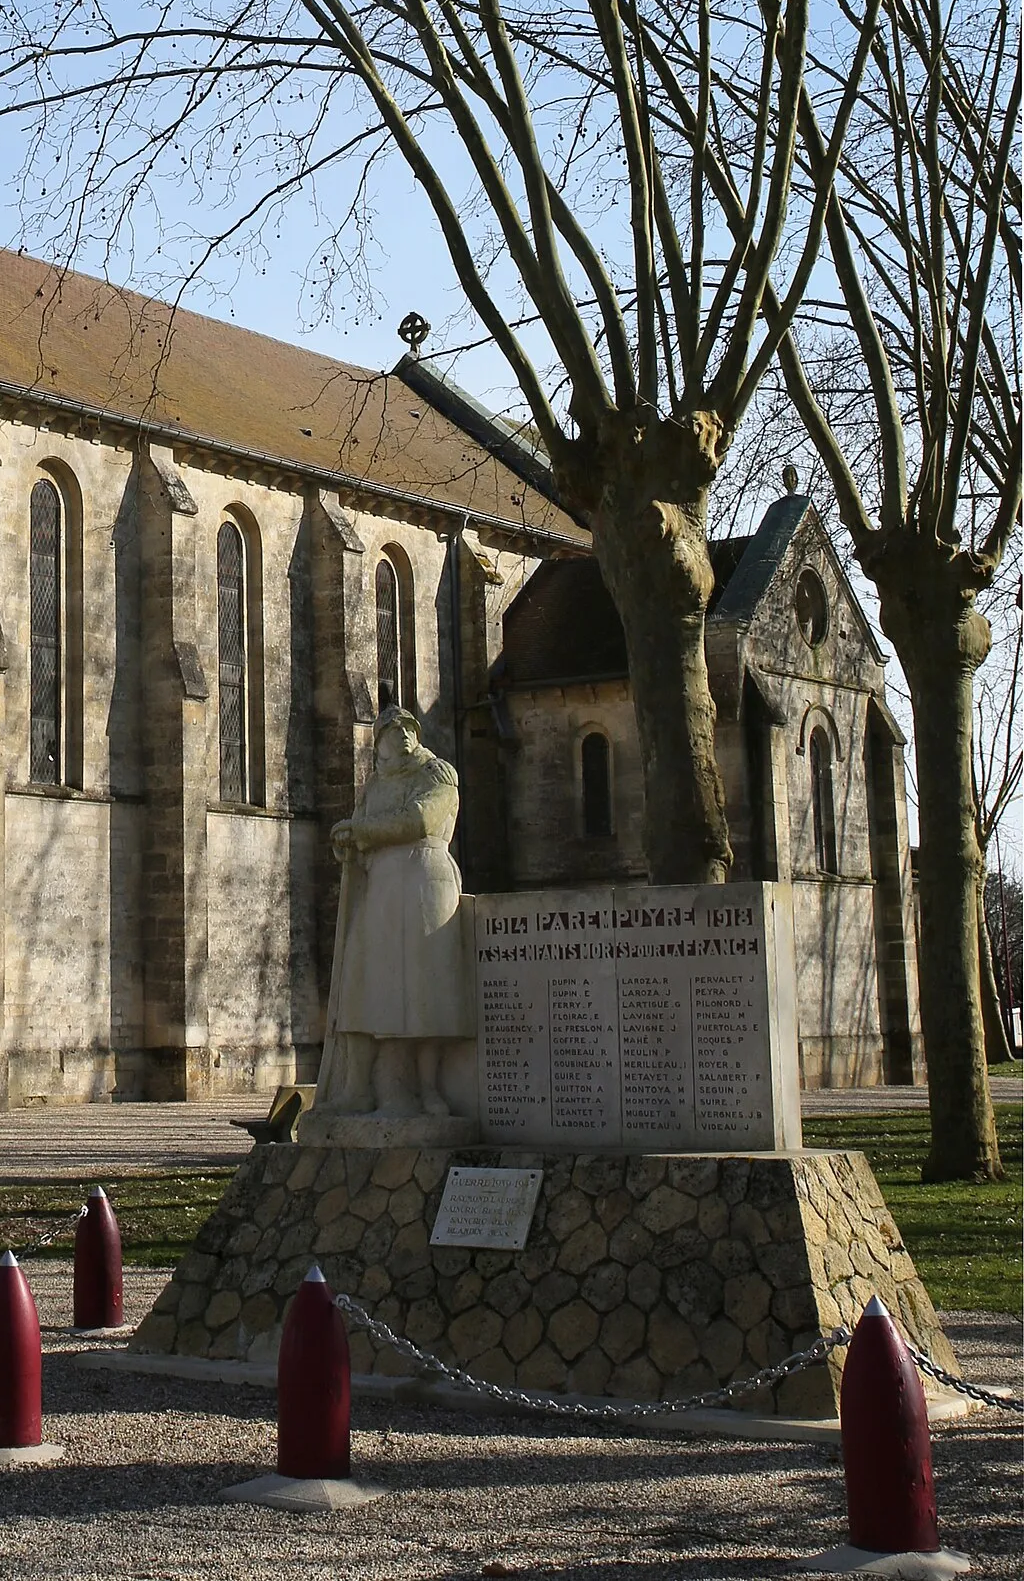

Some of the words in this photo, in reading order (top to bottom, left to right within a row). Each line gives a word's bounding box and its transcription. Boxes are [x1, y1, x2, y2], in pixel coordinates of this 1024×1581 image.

[486, 917, 527, 935] 1914
[537, 908, 695, 931] PAREMPUYRE
[708, 908, 752, 927] 1918
[516, 944, 580, 961] ENFANTS
[580, 941, 630, 960] MORTS
[631, 944, 664, 958] POUR
[664, 942, 684, 957] LA
[684, 939, 759, 956] FRANCE
[451, 1178, 491, 1187] GUERRE
